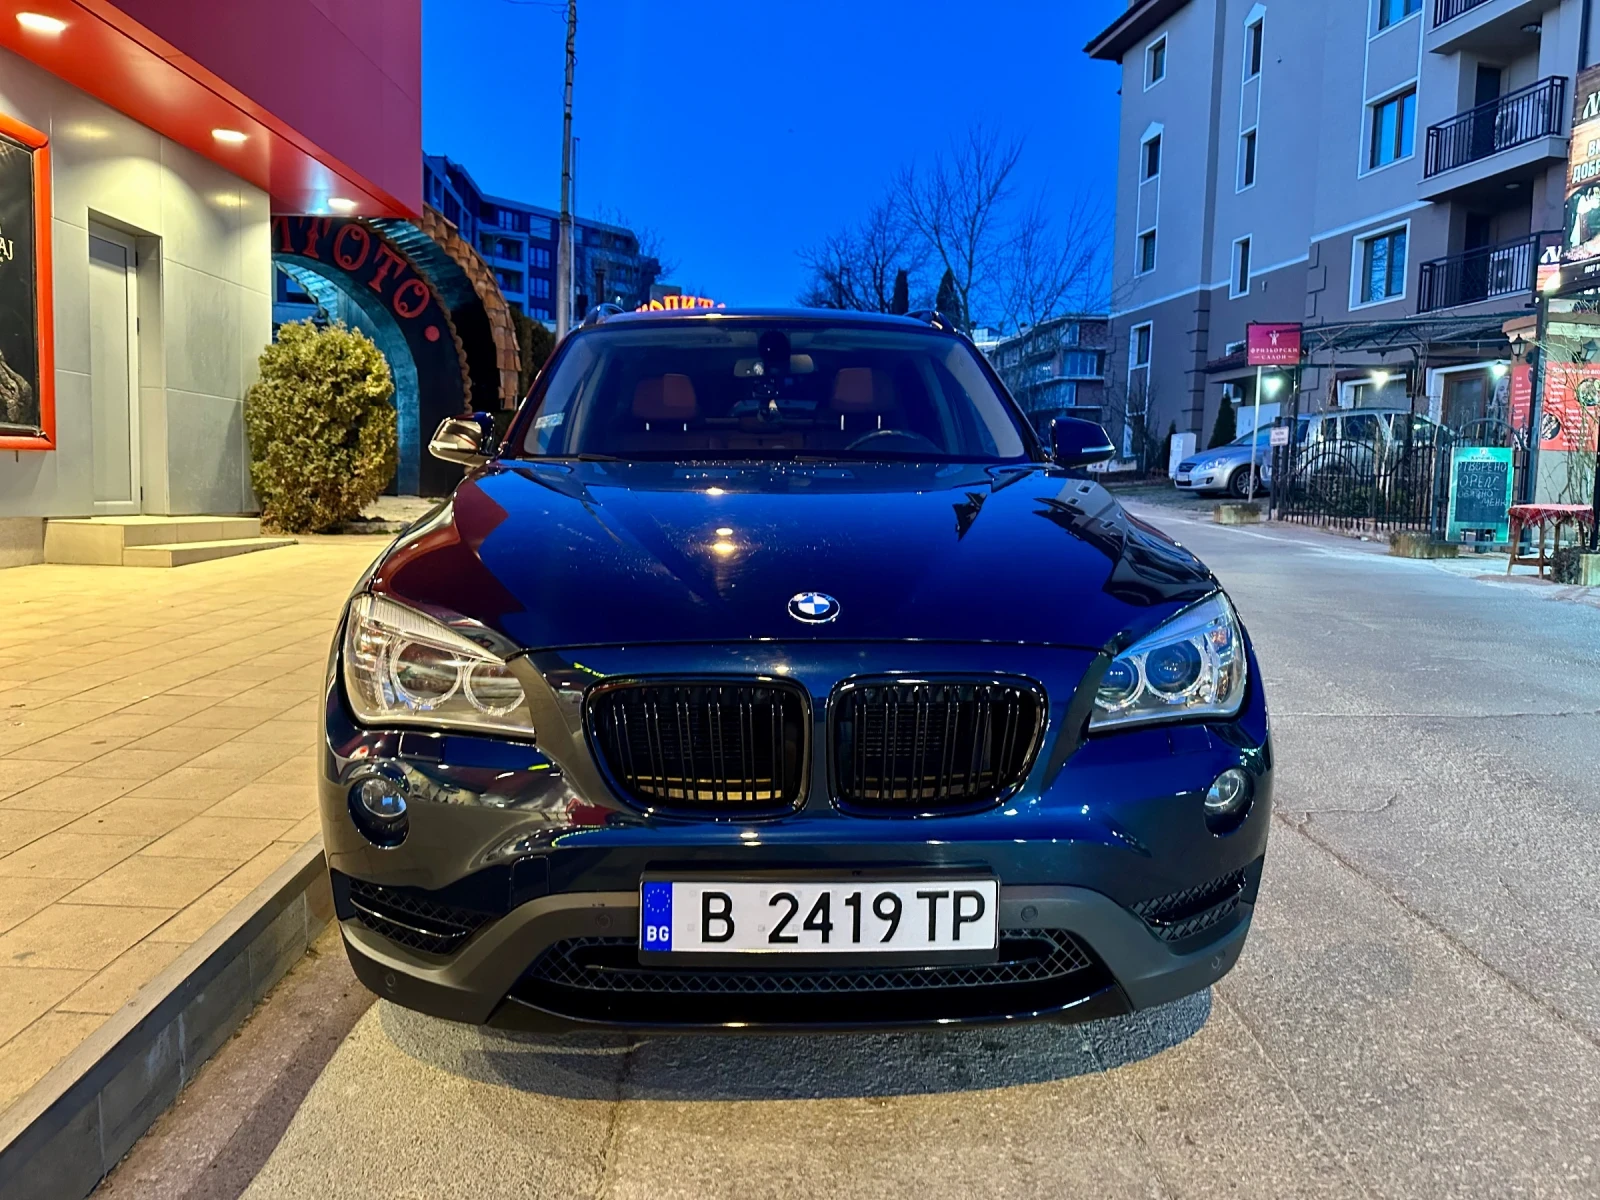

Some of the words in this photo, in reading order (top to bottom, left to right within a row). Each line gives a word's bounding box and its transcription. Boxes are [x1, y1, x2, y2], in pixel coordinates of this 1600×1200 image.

[1459, 475, 1499, 488] OPEN
[701, 891, 735, 943] B
[768, 891, 903, 944] 2419
[916, 890, 986, 942] TP
[646, 925, 669, 942] BG
